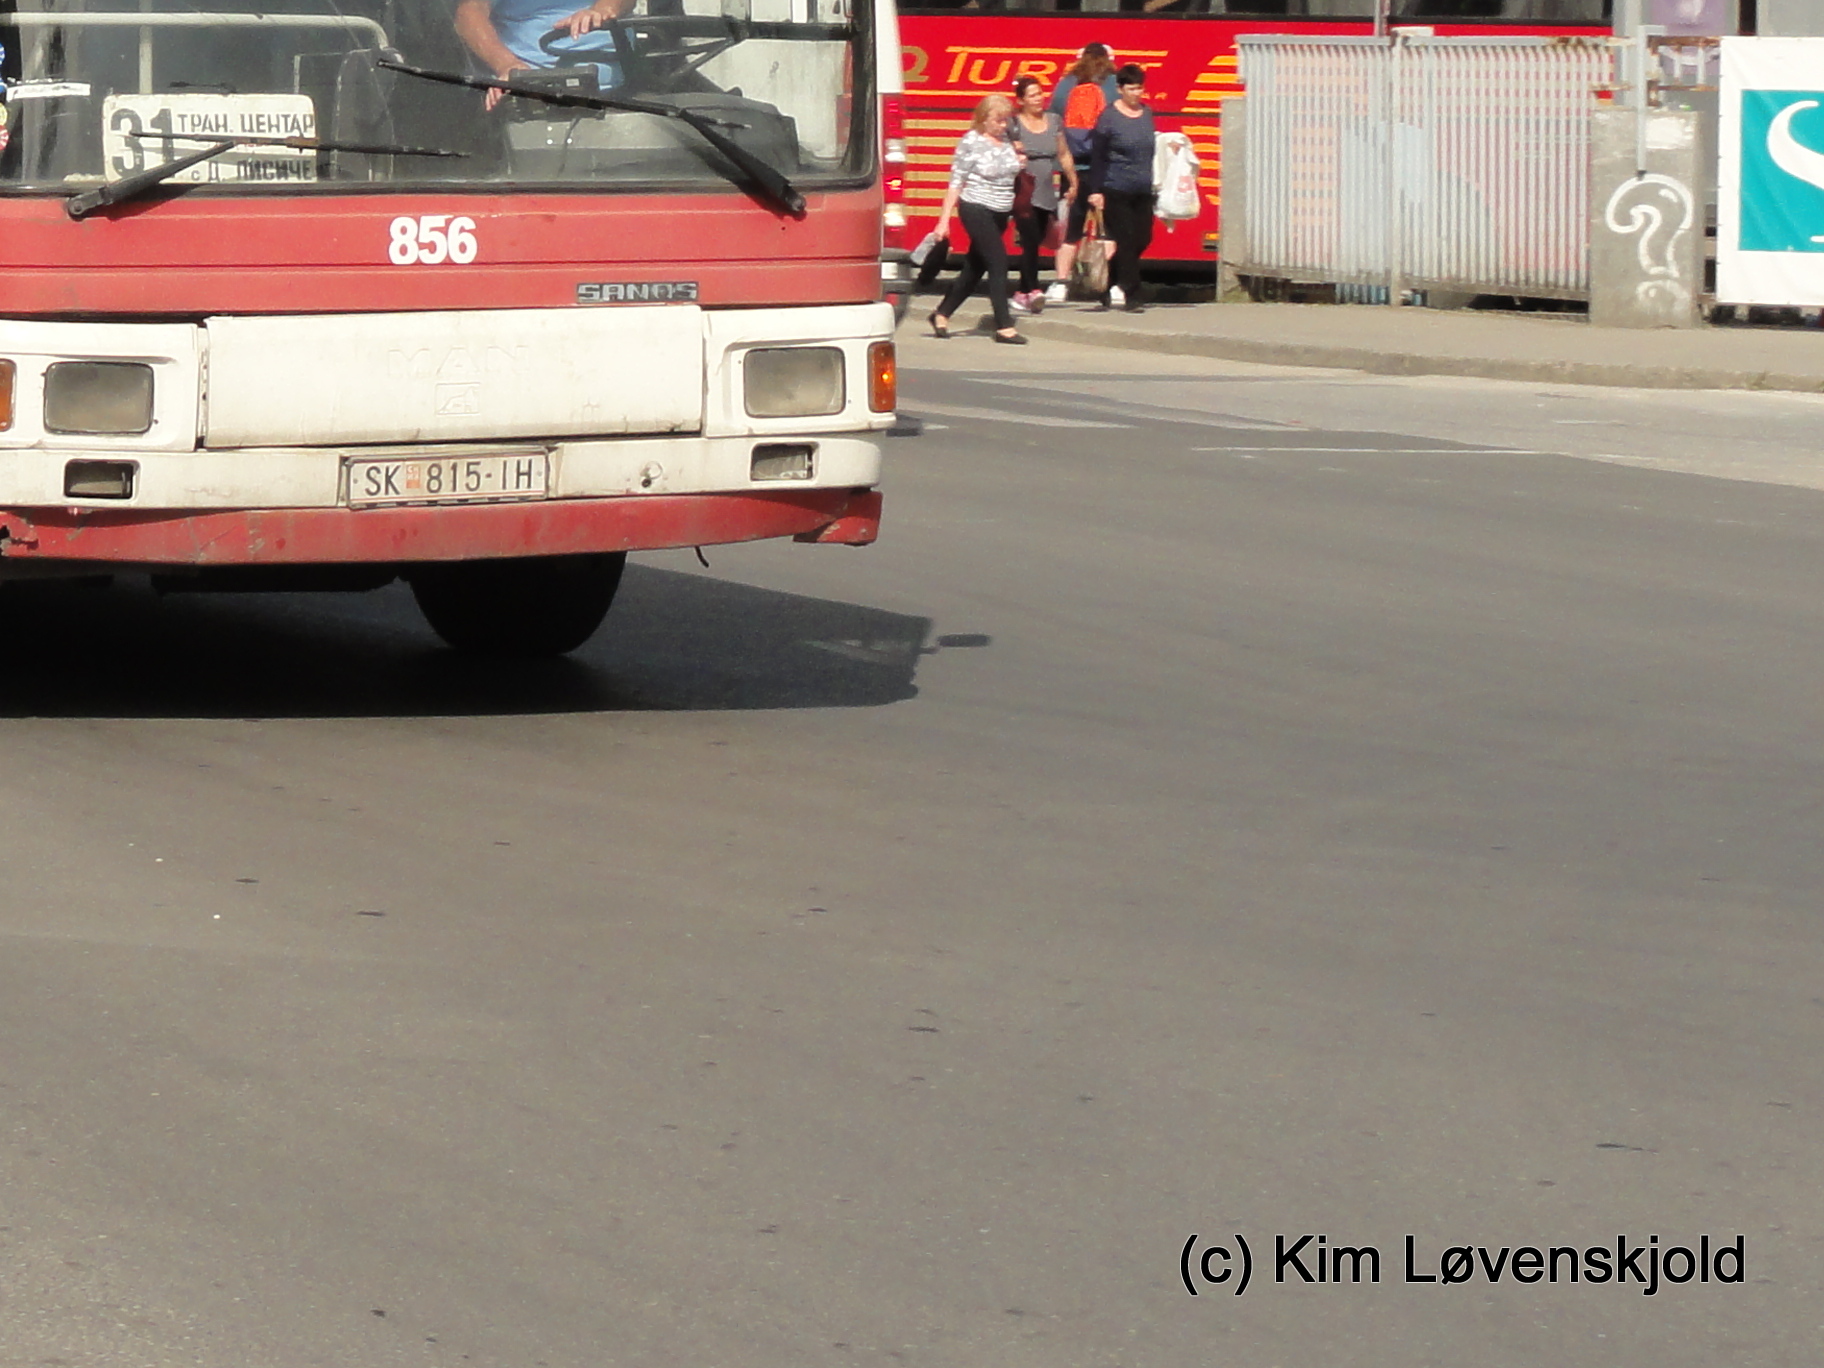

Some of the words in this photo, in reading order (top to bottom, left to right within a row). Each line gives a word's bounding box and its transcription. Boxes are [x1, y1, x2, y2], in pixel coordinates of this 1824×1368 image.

[177, 113, 234, 134] ТРАН.
[239, 113, 314, 134] ЦЕНТАР
[110, 107, 174, 179] 31
[389, 215, 478, 265] 856
[388, 345, 528, 378] MAN
[364, 464, 401, 497] SK
[426, 459, 533, 494] 815-IH
